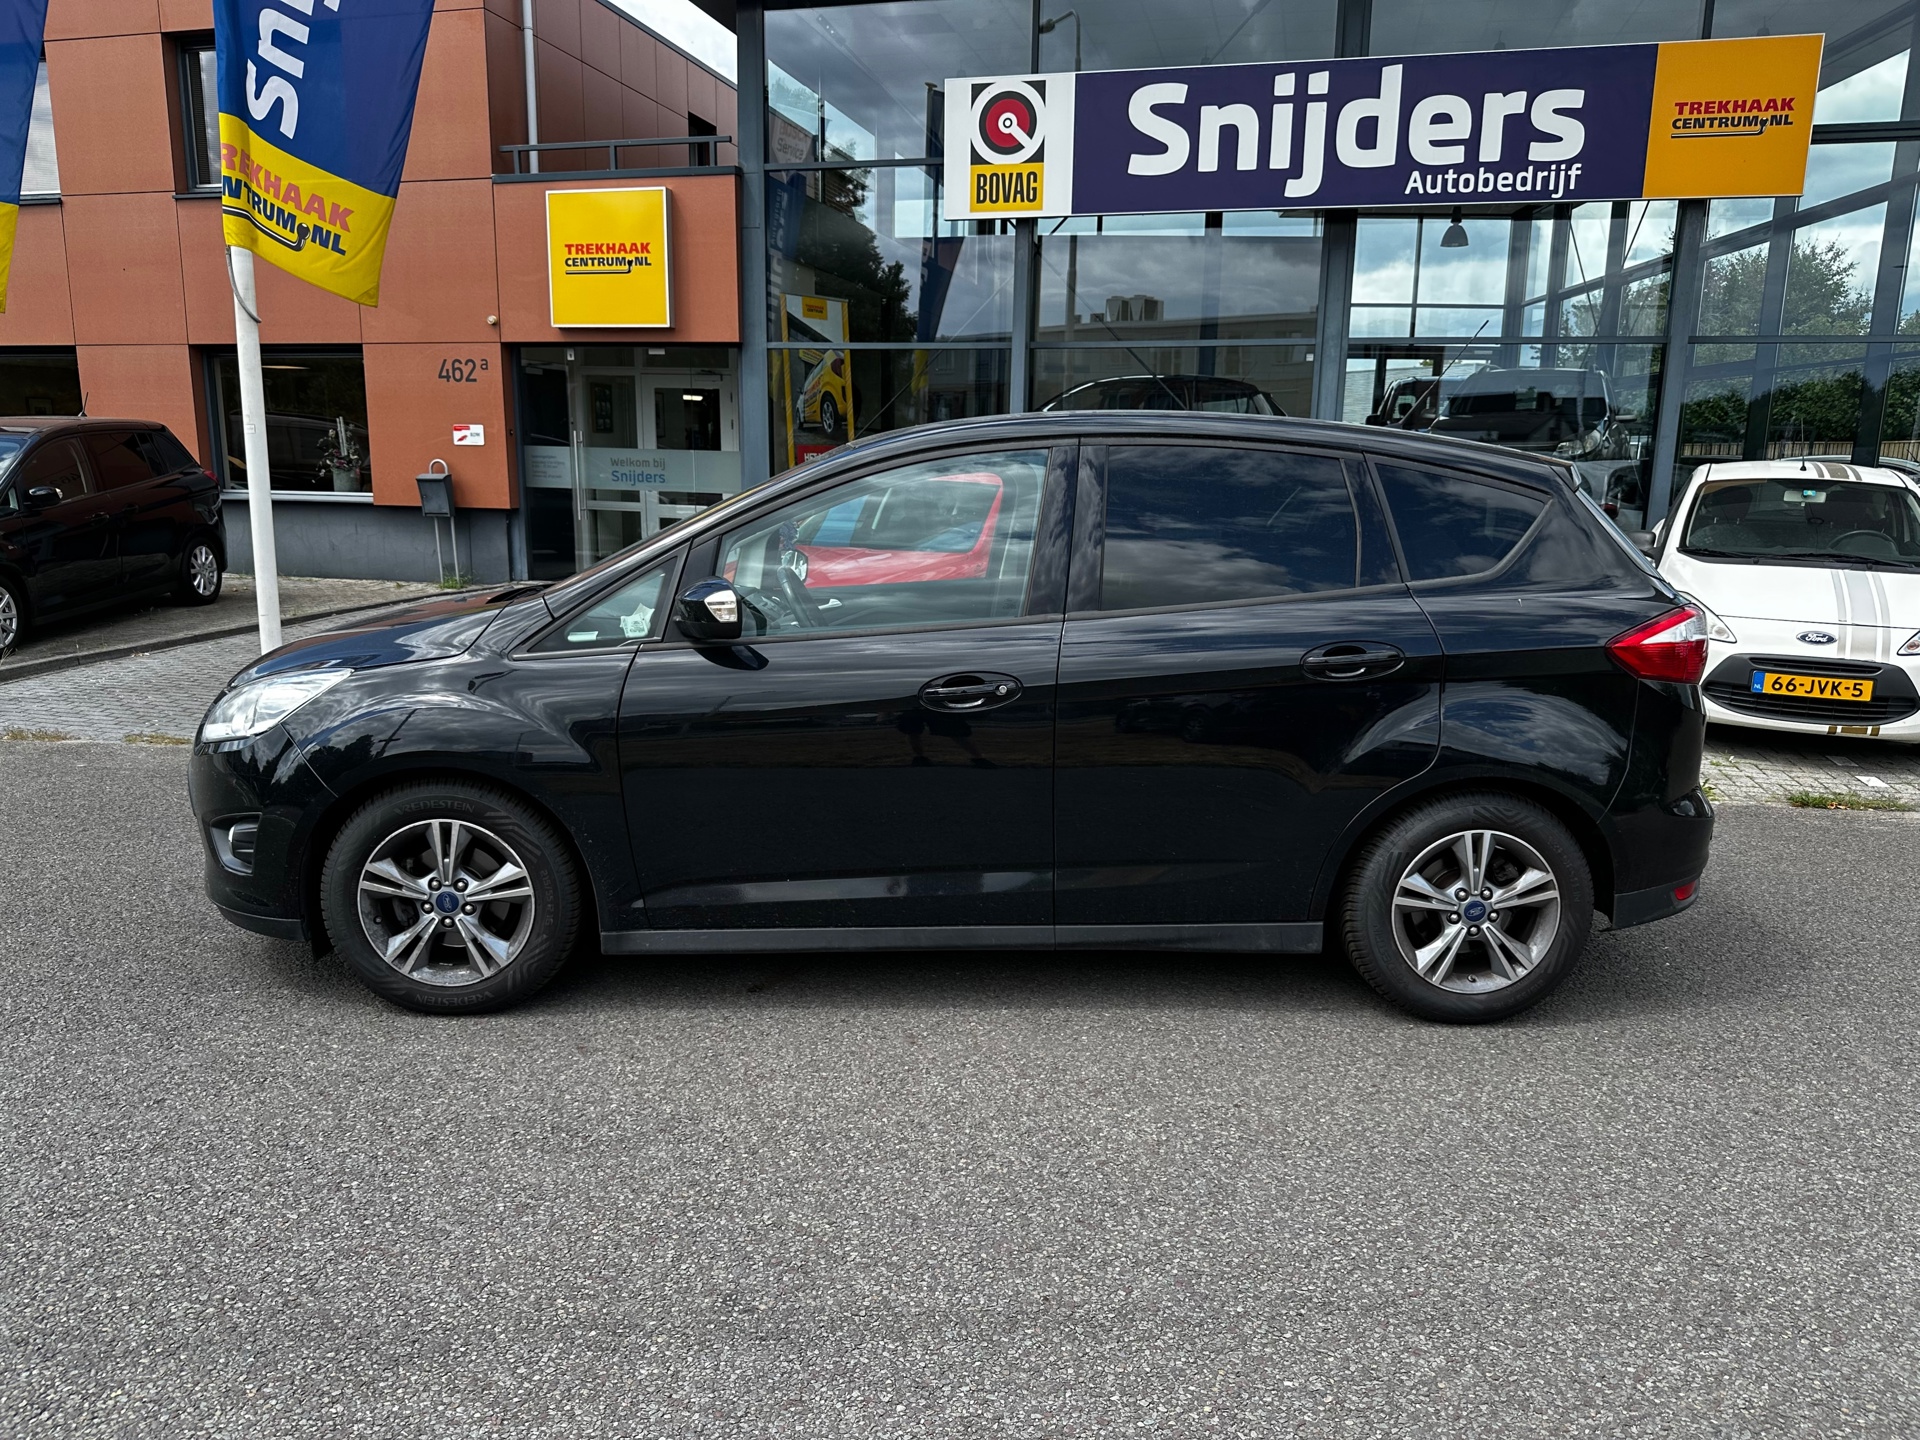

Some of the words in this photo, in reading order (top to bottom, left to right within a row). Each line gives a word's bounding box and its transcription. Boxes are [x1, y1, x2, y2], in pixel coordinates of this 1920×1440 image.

[1674, 97, 1795, 115] TREKHAAK
[1127, 64, 1586, 198] Snijders
[976, 171, 1038, 204] BOVAG
[1404, 163, 1583, 199] Autobedrijf
[564, 242, 651, 255] TREKHAAK
[610, 457, 651, 468] Welkom
[653, 457, 666, 471] bij
[611, 470, 666, 486] Snijders
[1805, 633, 1829, 643] Ford
[1771, 676, 1864, 698] 66-JVK-5
[394, 799, 476, 815] VREDESTEIN
[415, 991, 495, 1007] VREDESTEIN
